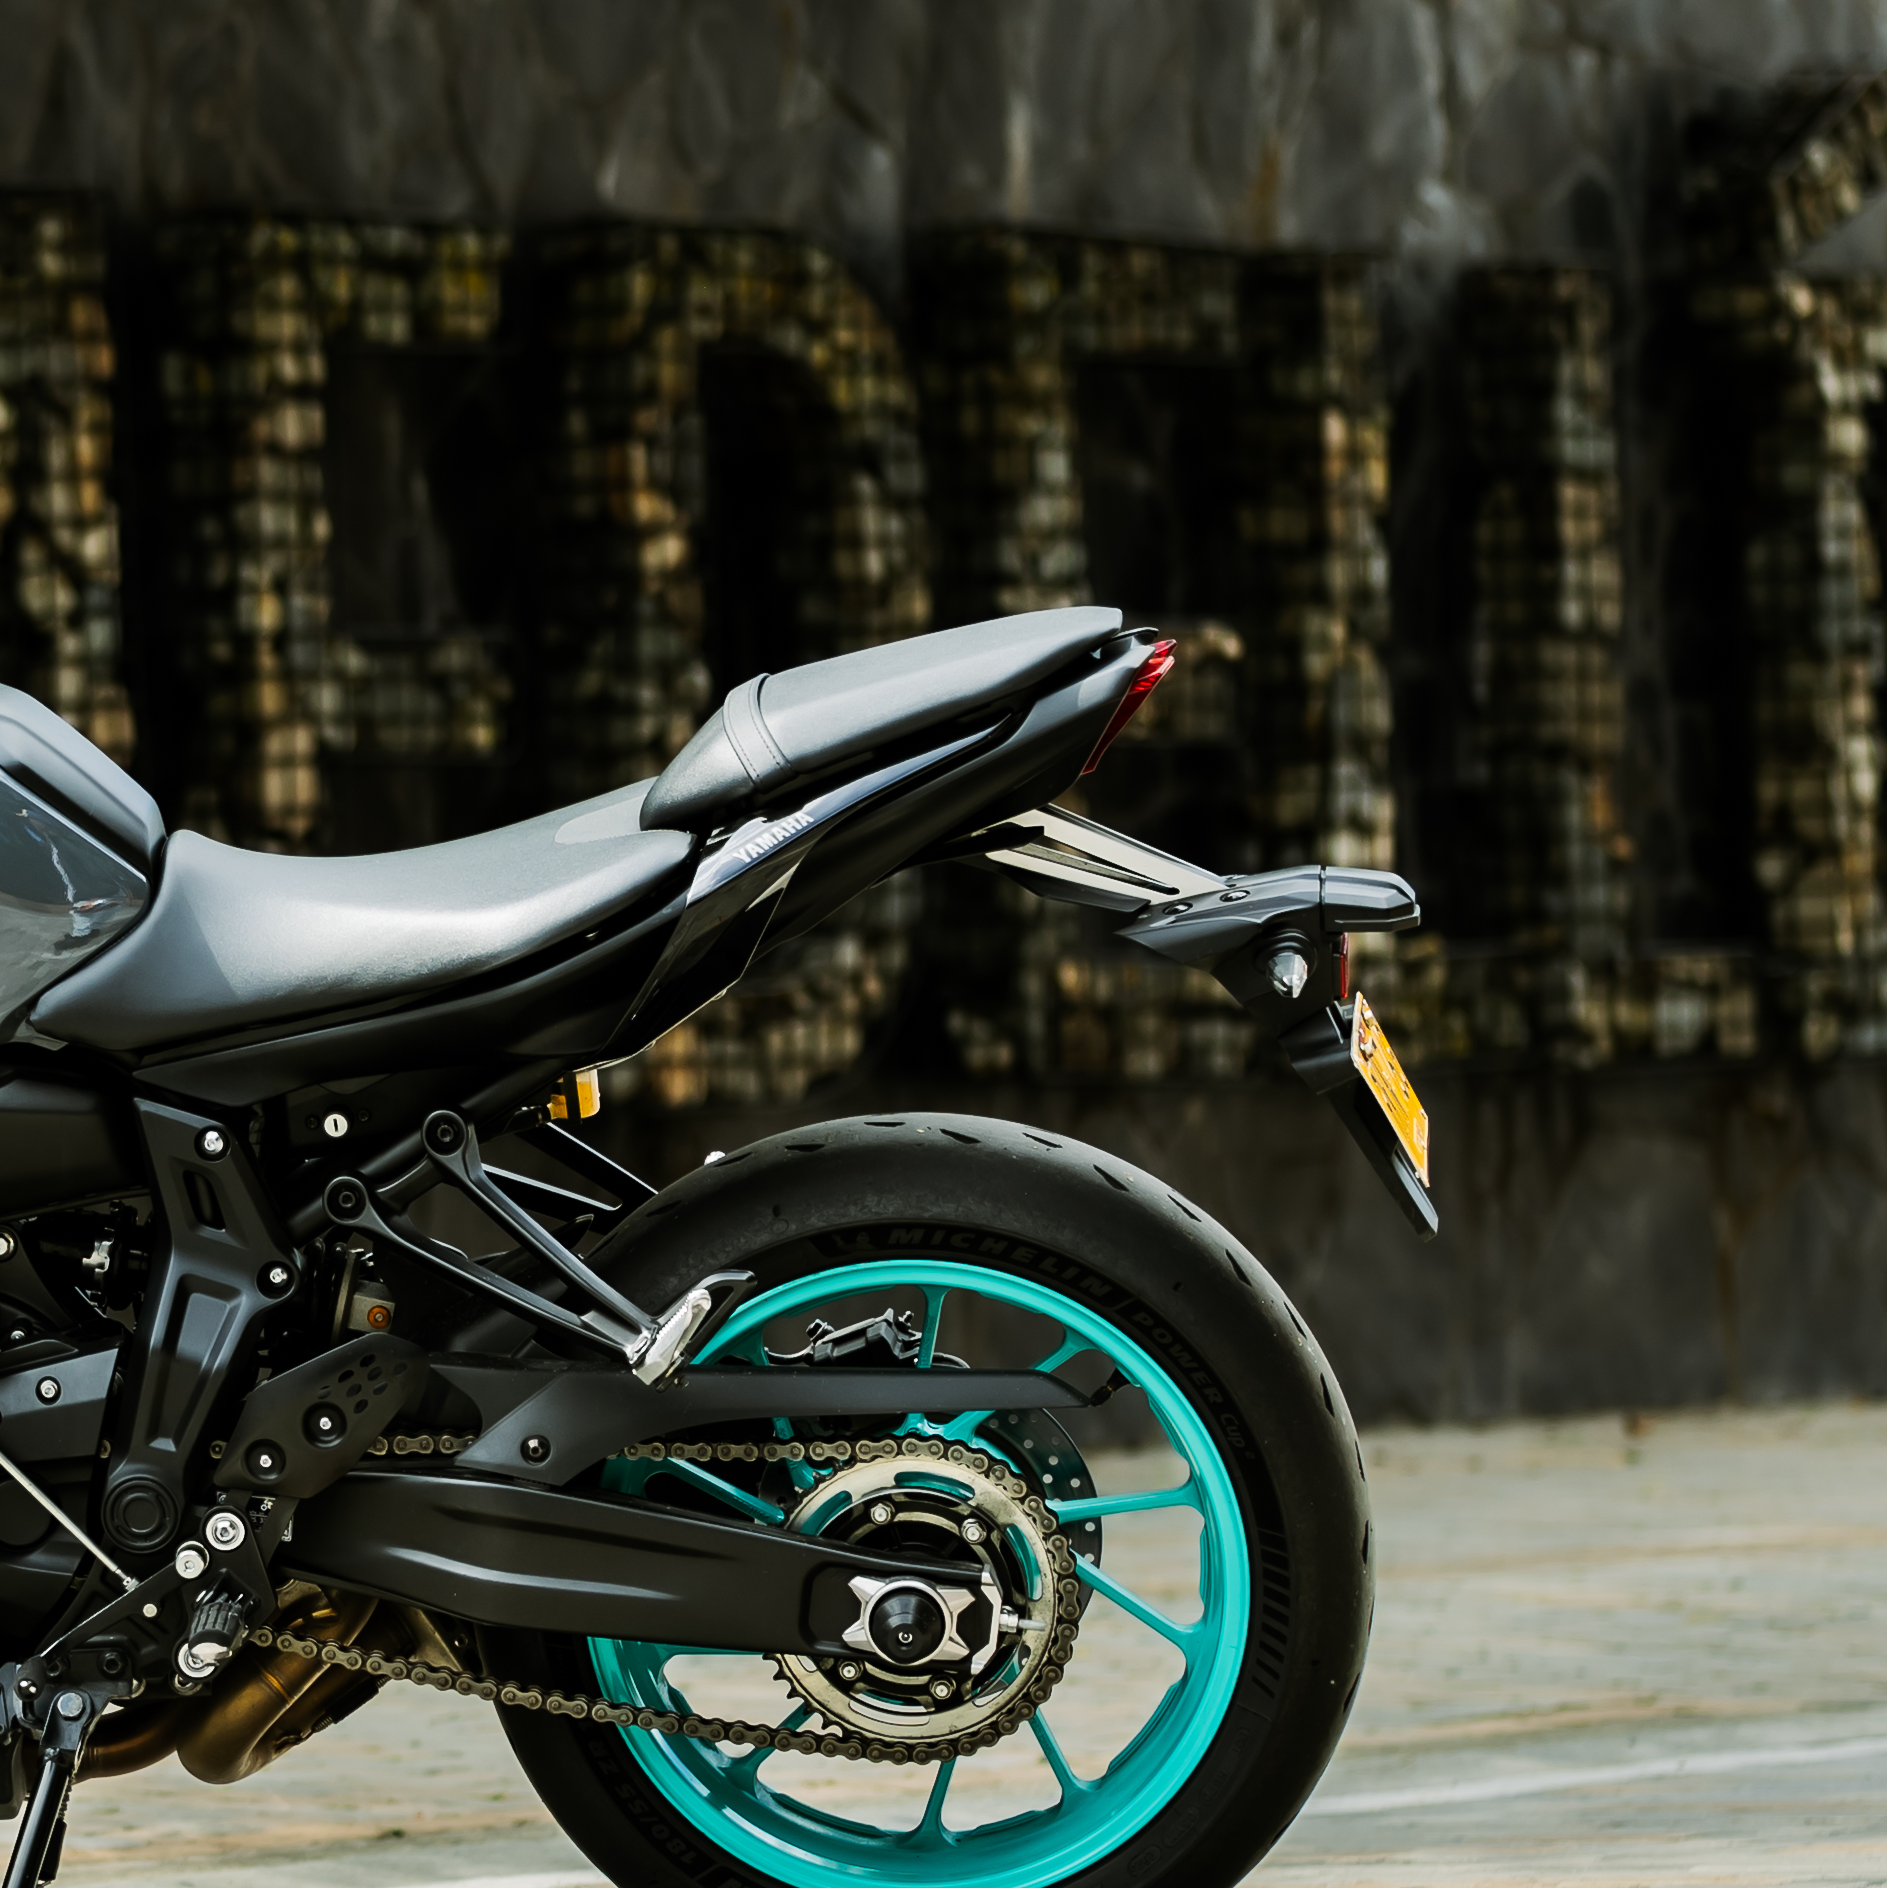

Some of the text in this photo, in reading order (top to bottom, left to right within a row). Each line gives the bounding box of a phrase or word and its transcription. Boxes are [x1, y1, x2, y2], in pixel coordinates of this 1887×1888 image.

[734, 813, 814, 863] YAMAHA
[887, 1227, 1114, 1299] MICHELIN
[1131, 1309, 1224, 1406] POWER
[587, 1738, 620, 1777] ZR
[615, 1781, 698, 1866] 180/55
